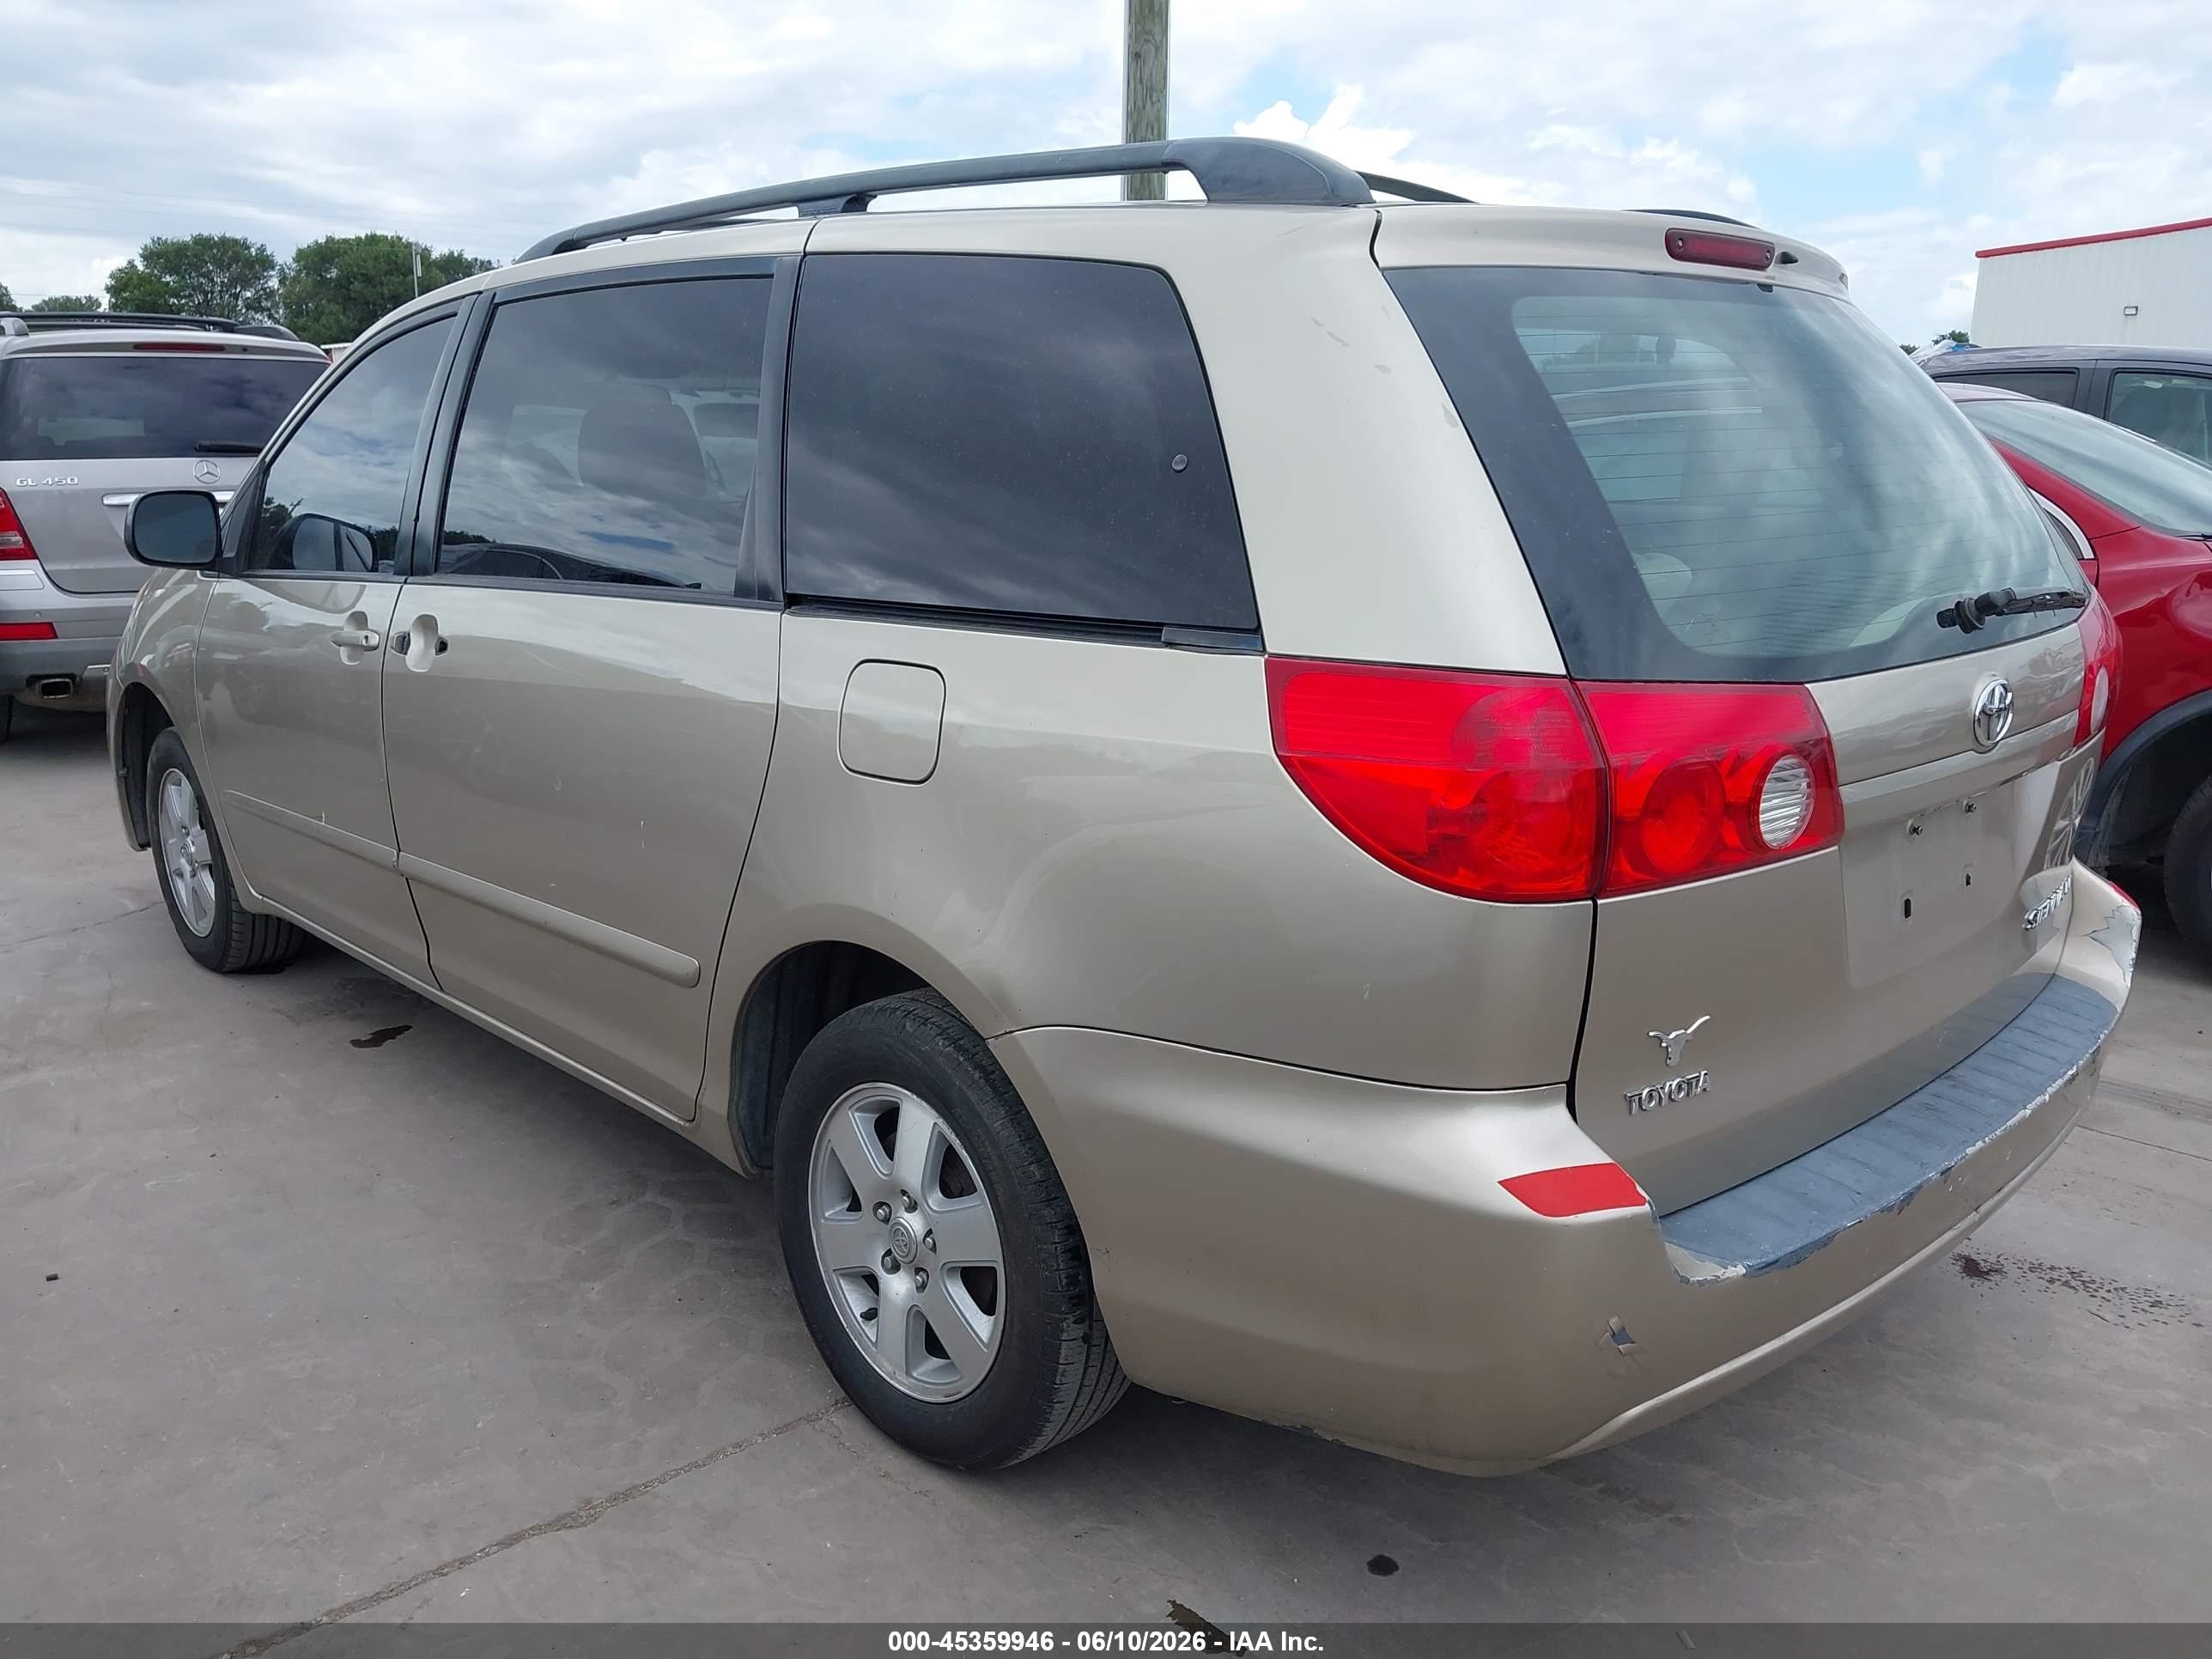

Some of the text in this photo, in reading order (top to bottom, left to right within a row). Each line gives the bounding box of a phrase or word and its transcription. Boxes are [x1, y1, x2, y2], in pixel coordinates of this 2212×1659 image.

[16, 476, 78, 487] GL 450
[1624, 1070, 1711, 1115] TOYOTA
